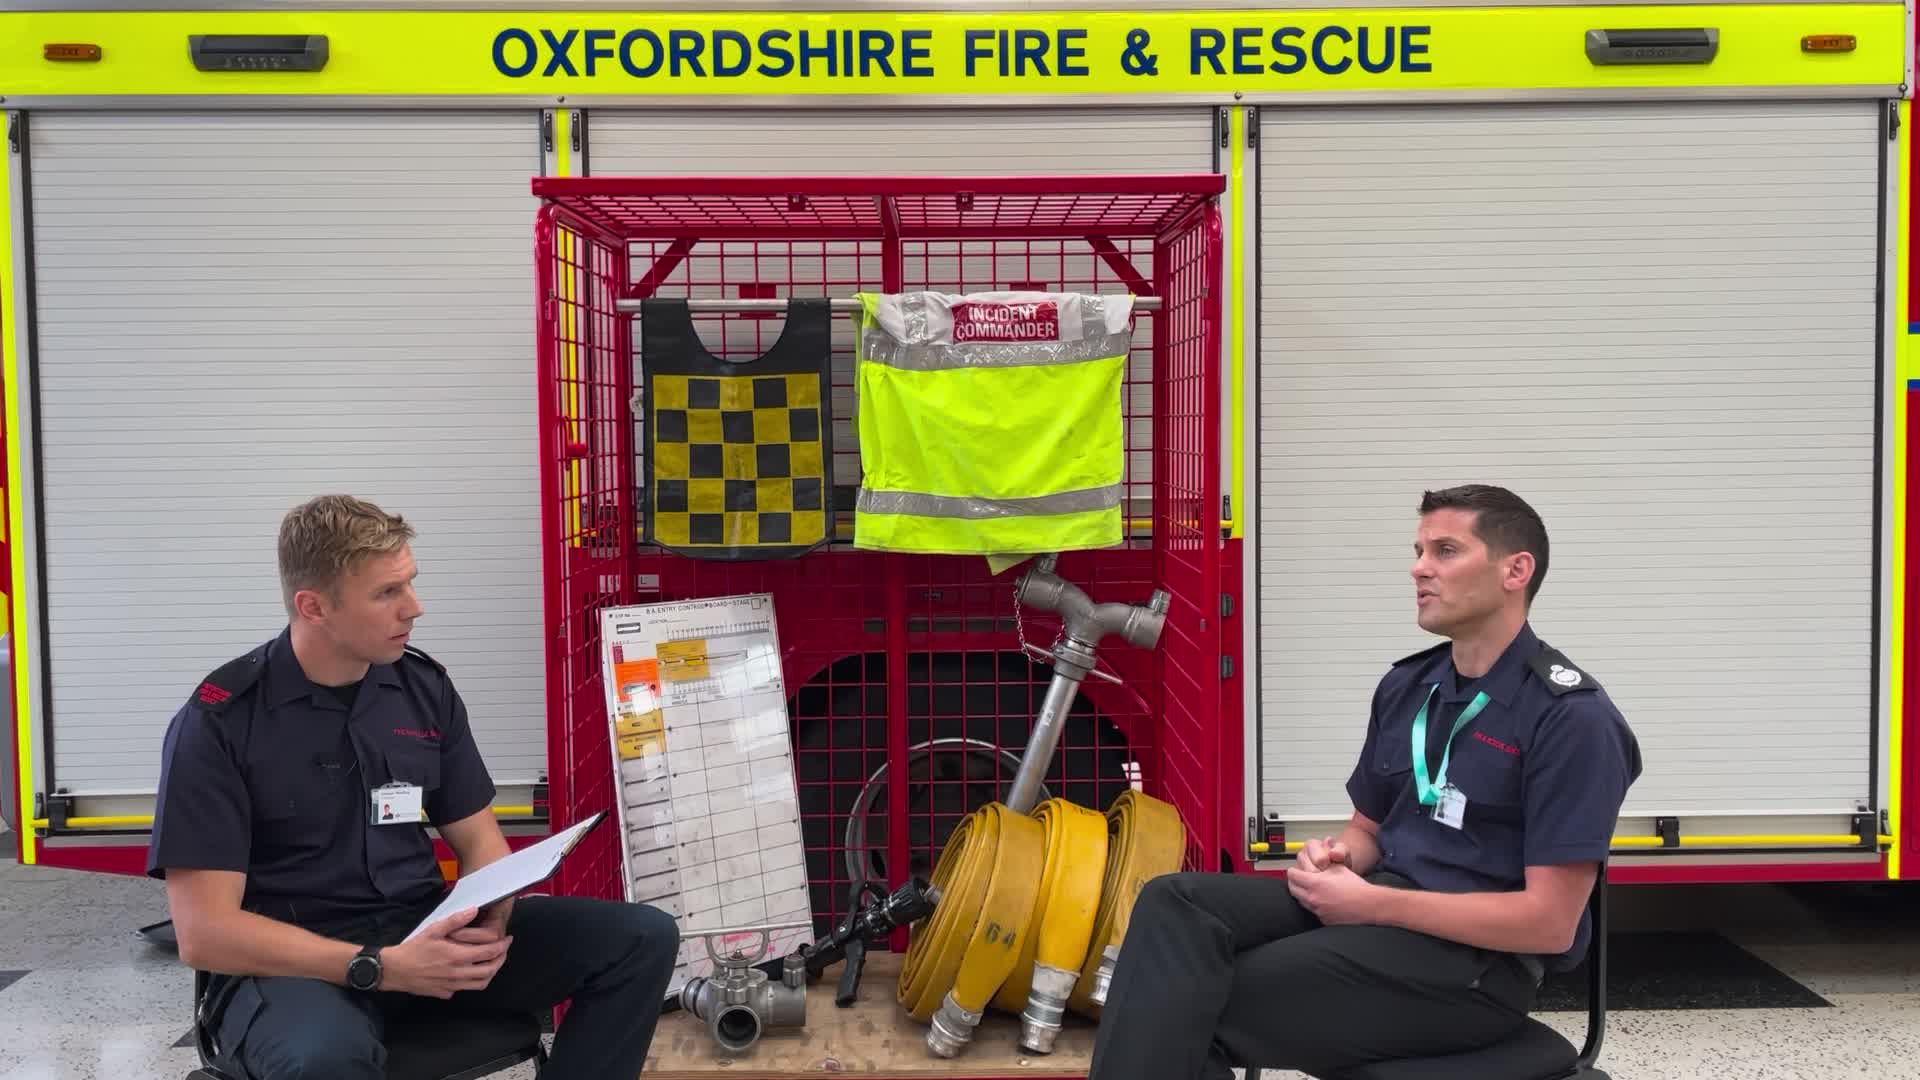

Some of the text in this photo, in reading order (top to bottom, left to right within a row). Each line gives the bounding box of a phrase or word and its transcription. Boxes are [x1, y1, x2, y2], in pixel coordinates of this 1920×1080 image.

[492, 26, 1431, 77] OXFORDSHIRE FIRE & RESCUE
[968, 303, 1038, 322] INCIDENT
[956, 321, 1056, 340] COMMANDER
